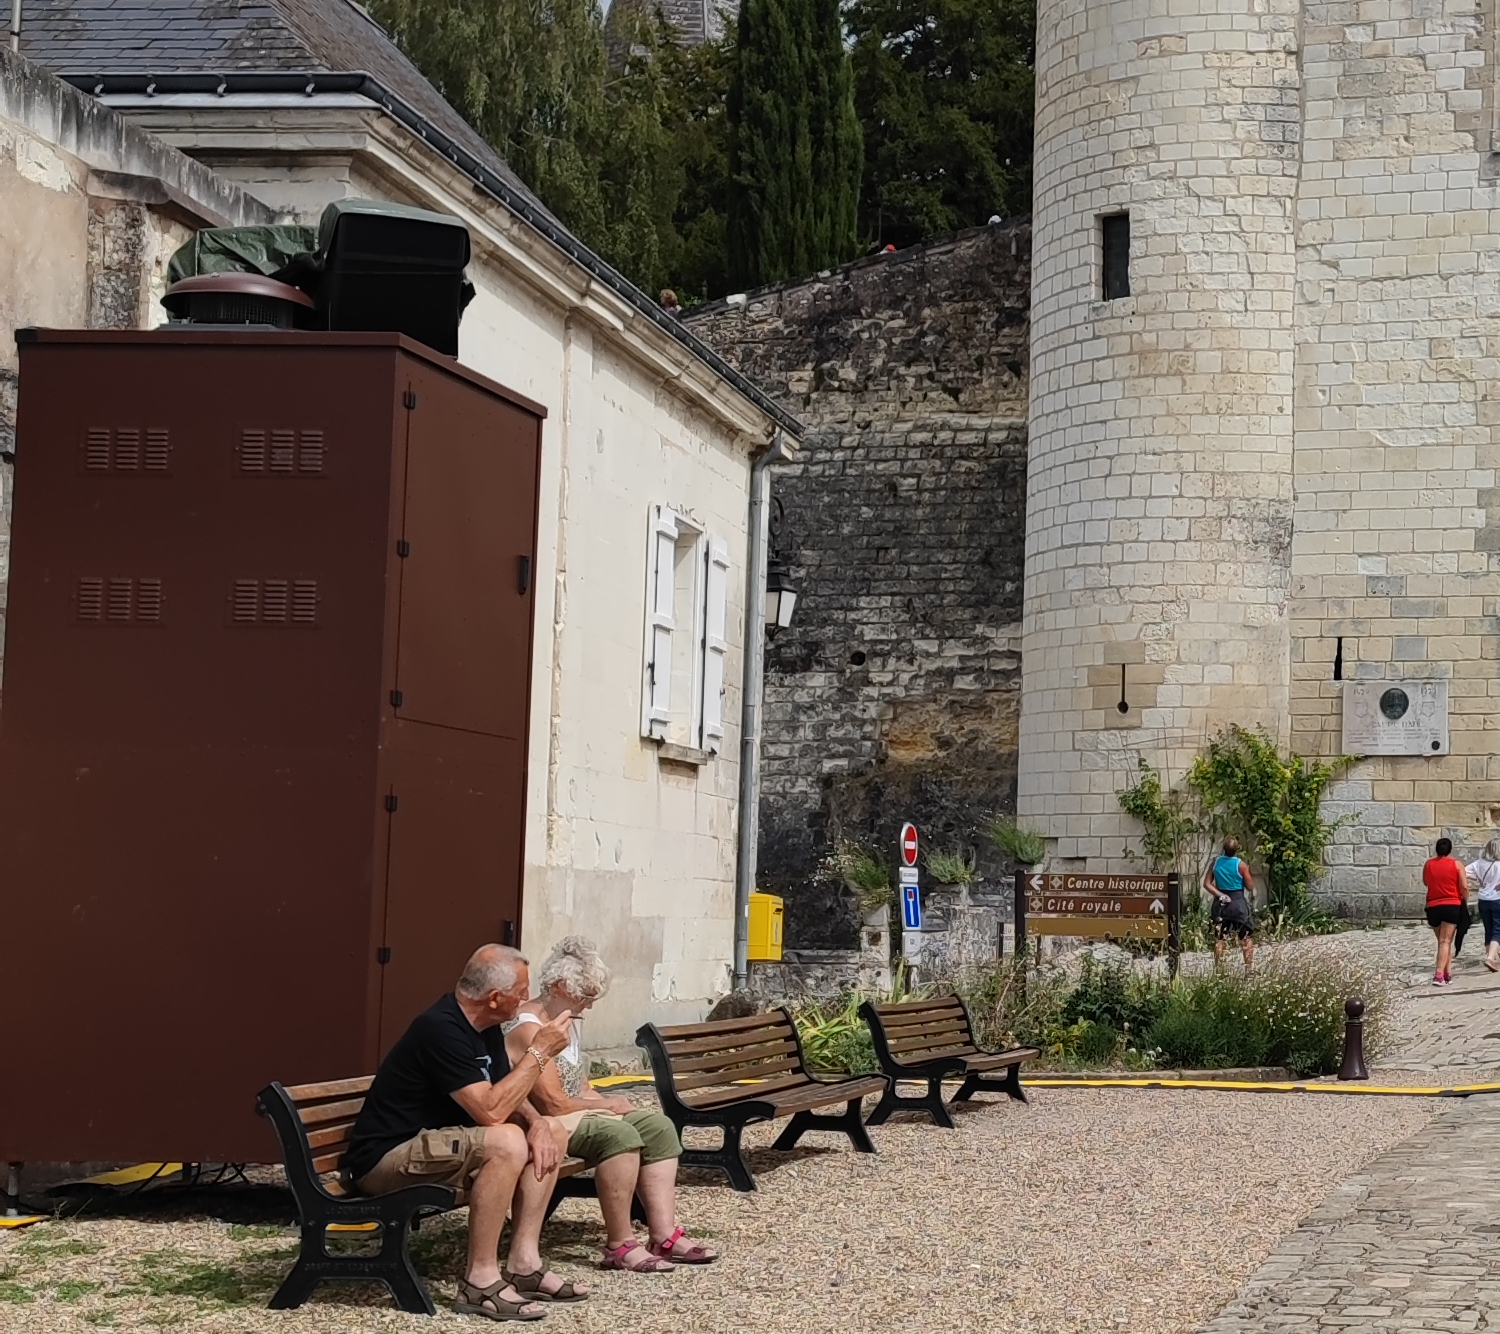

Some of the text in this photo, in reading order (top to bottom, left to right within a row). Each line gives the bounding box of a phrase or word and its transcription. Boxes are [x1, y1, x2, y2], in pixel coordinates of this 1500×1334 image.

[1067, 877, 1165, 892] Centre historique
[1047, 899, 1122, 914] Cité royale
